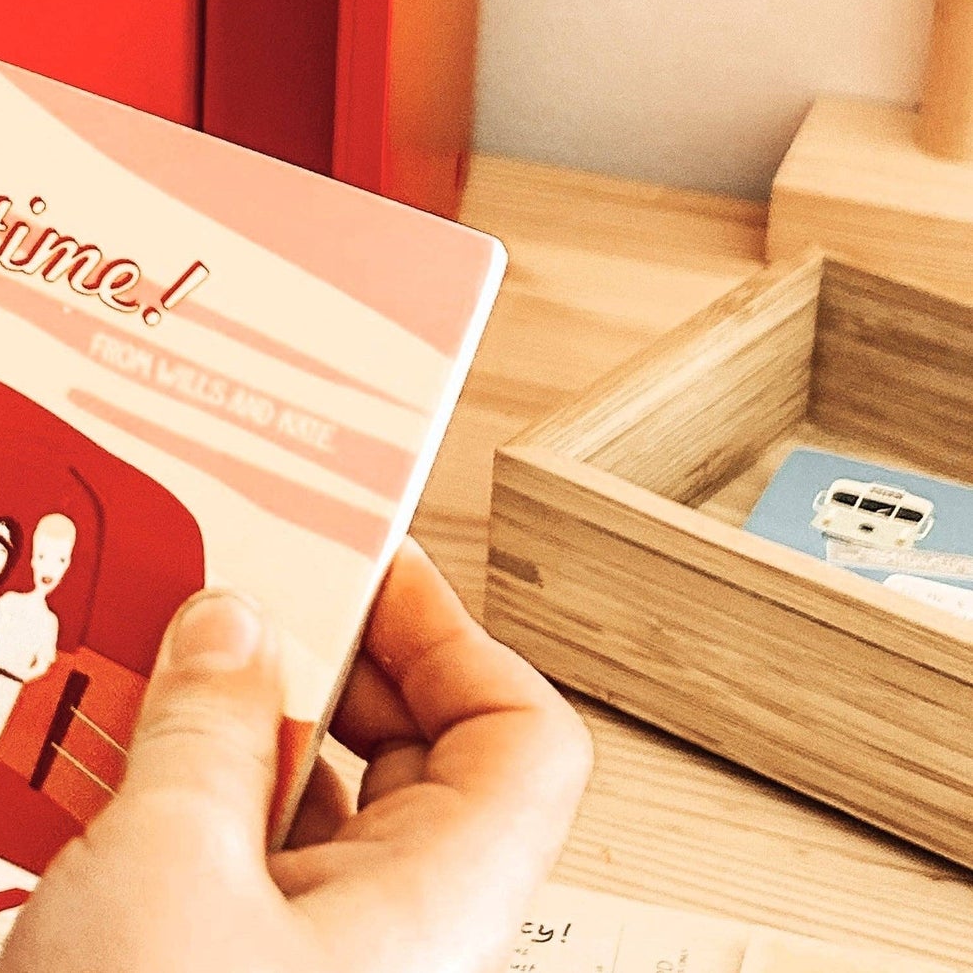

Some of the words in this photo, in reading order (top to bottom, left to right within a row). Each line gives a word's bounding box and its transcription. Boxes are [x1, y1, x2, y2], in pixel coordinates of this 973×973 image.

[89, 331, 155, 382] FROM
[155, 358, 228, 407] WILLS
[226, 387, 277, 426] AND
[277, 408, 337, 451] KATE
